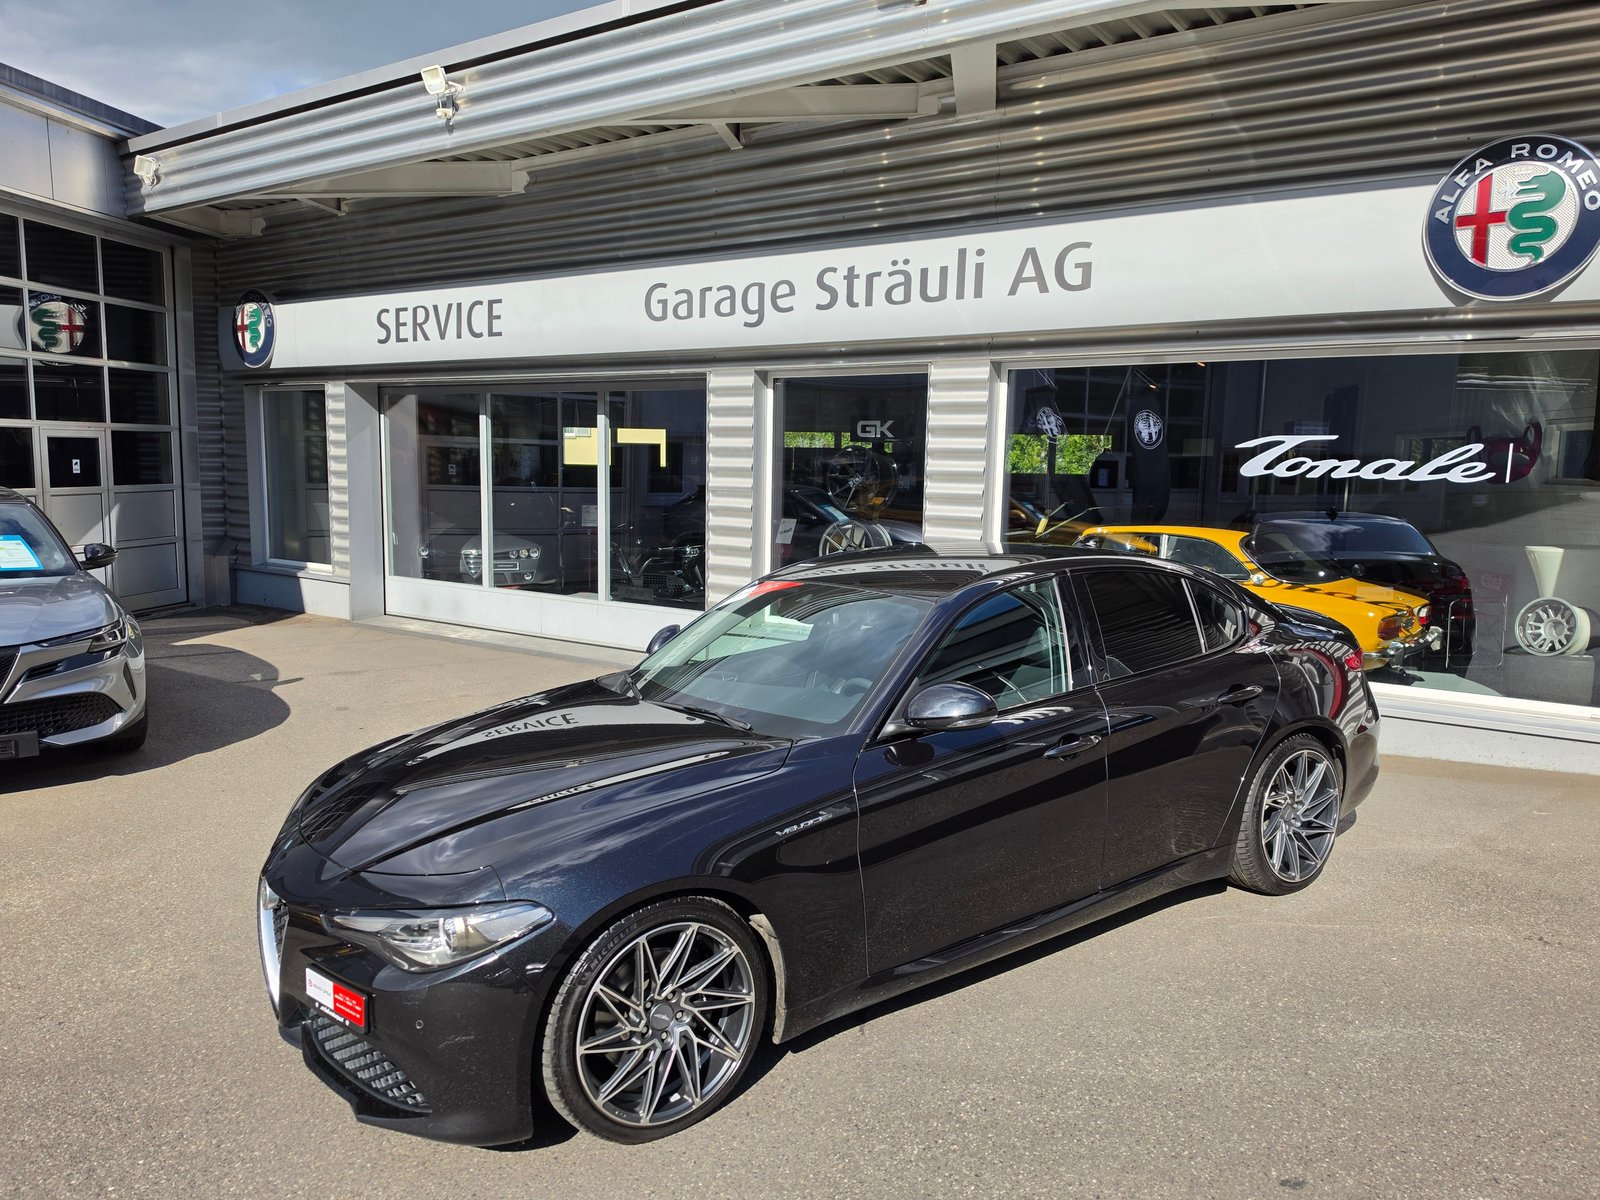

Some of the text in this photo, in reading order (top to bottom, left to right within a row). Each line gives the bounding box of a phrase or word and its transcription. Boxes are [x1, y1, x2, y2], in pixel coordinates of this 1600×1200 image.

[1434, 142, 1600, 225] ALFA ROMEO
[644, 241, 1093, 328] Garage Sträuli AG
[376, 298, 503, 345] SERVICE
[856, 420, 895, 438] GK
[1235, 434, 1497, 484] Tonale
